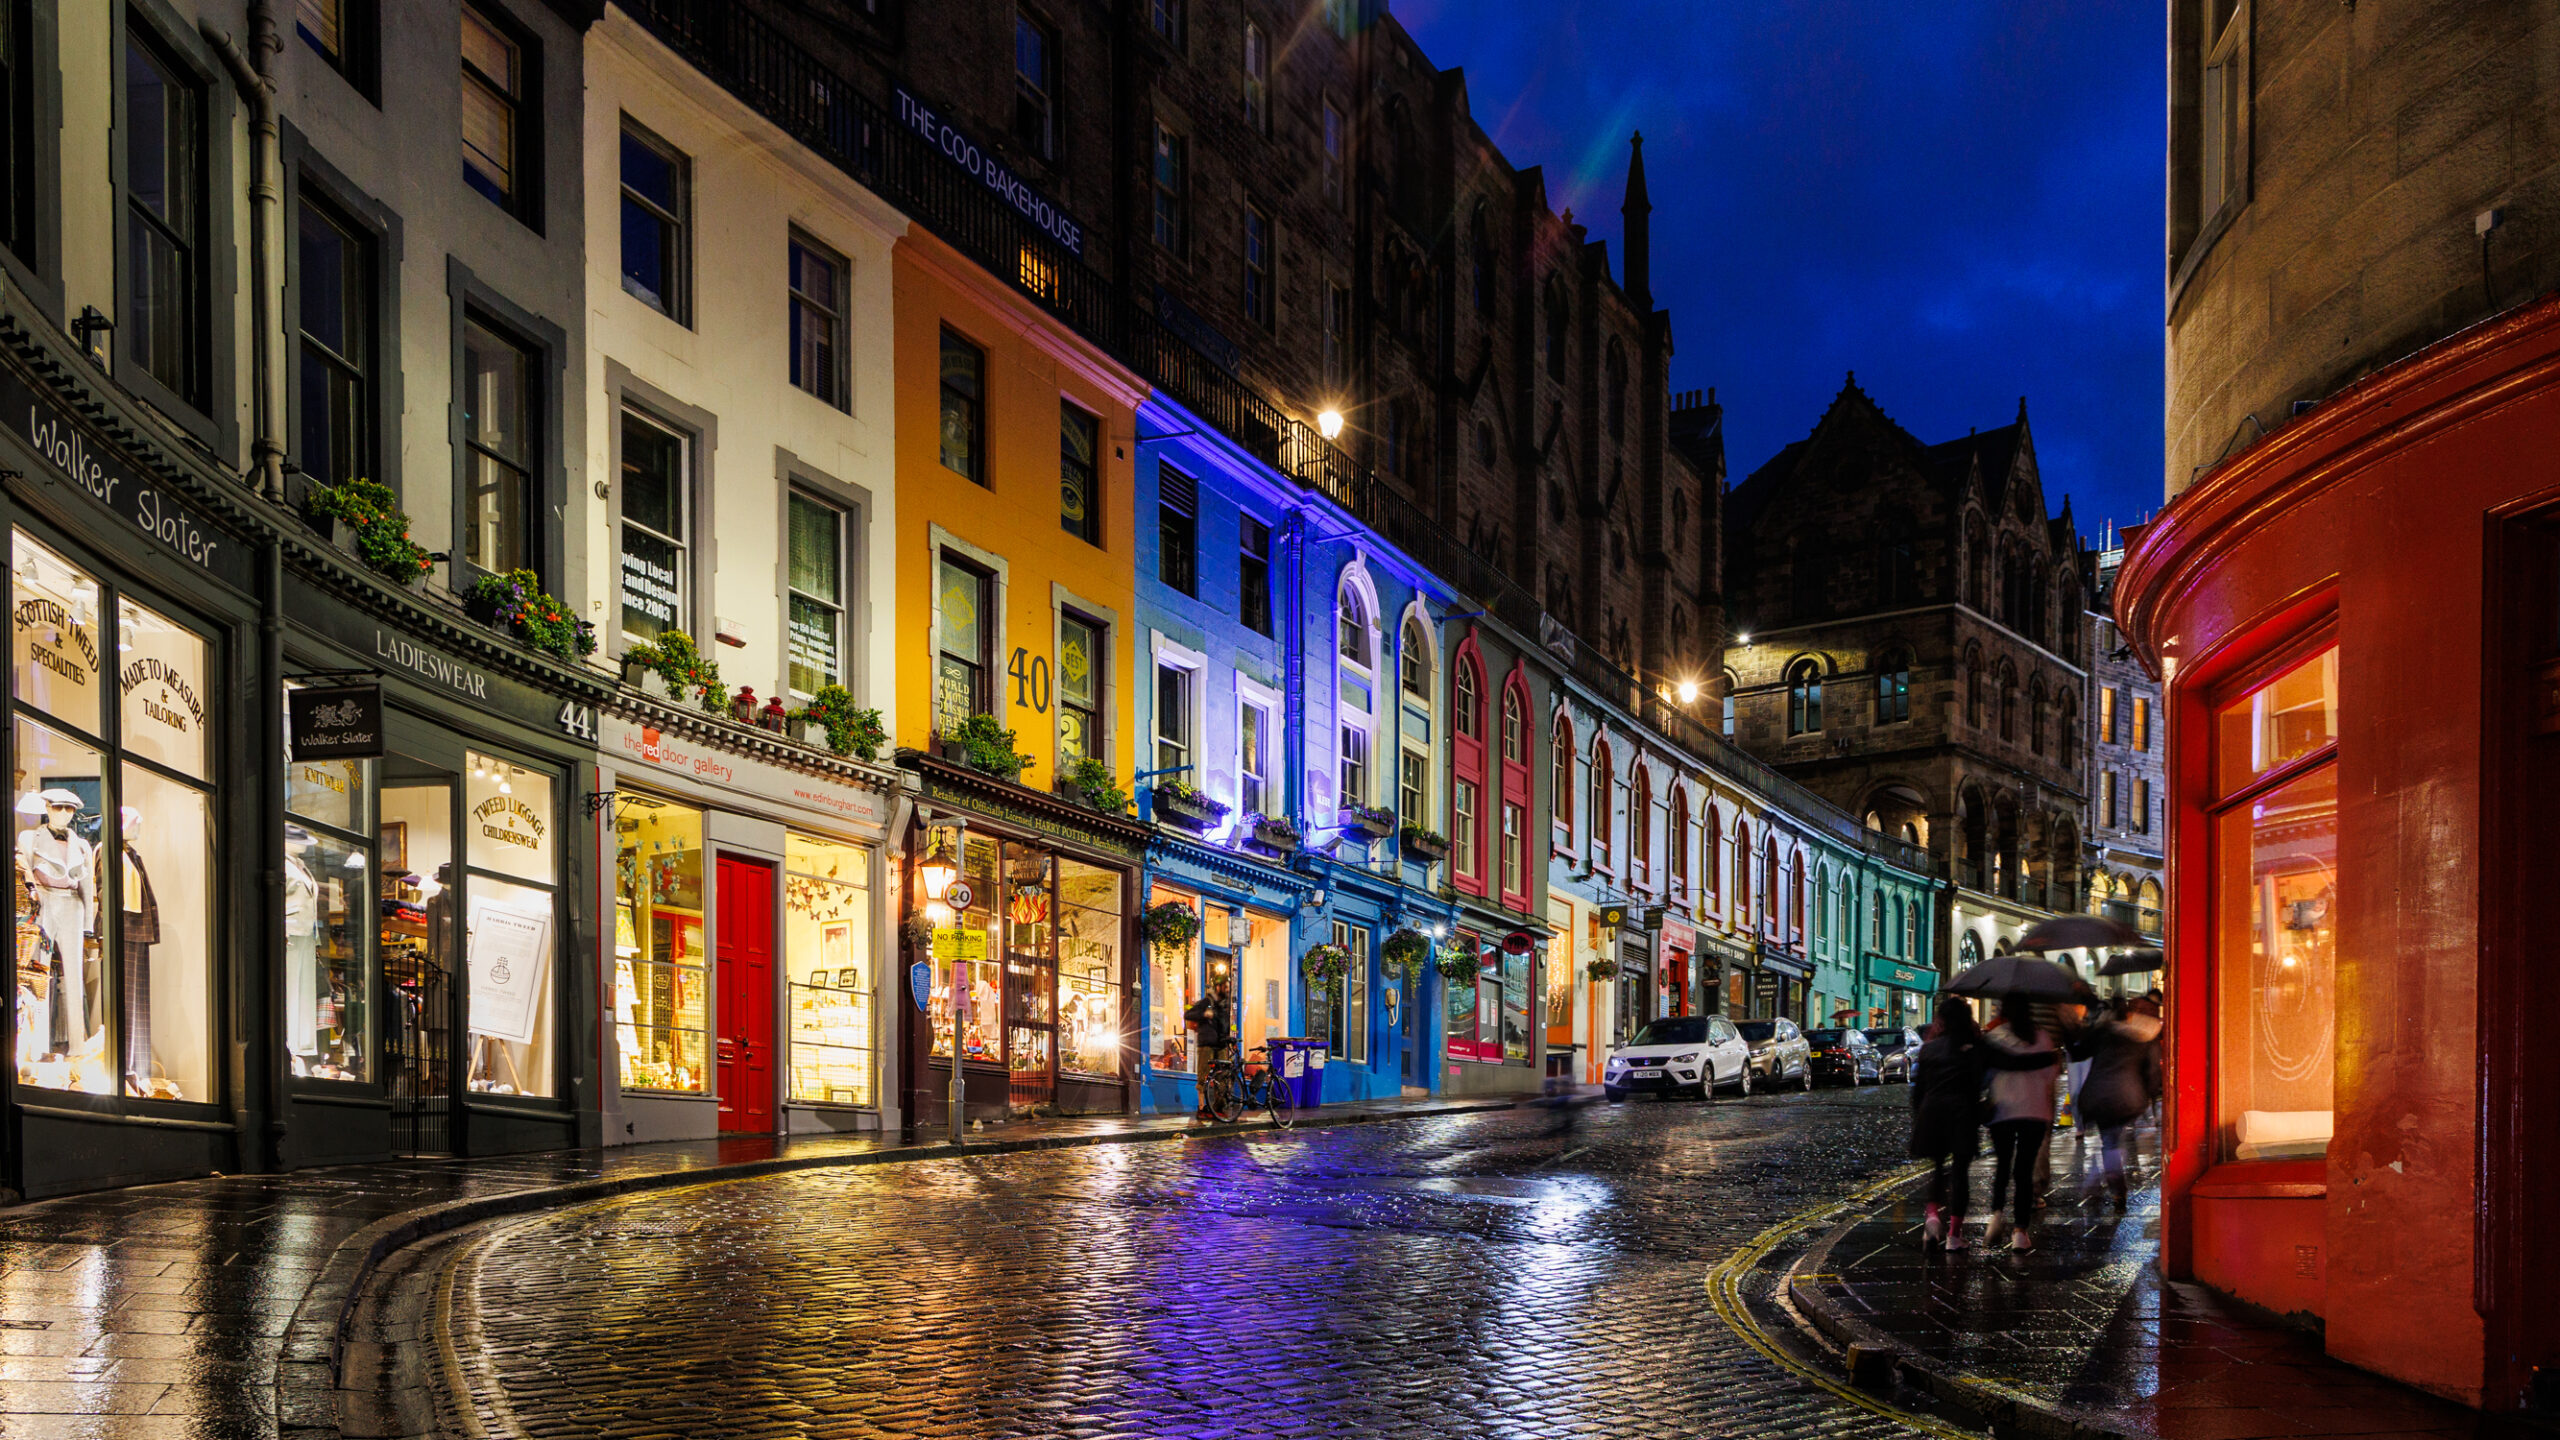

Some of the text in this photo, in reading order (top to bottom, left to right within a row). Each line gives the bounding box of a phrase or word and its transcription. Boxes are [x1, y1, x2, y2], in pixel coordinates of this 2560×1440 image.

[897, 88, 1081, 255] THE COO BAKEHOUSE
[32, 404, 217, 567] Walker Slater
[624, 572, 644, 593] and
[644, 578, 678, 606] Design
[647, 560, 674, 586] Local
[645, 598, 671, 622] 2003
[14, 598, 100, 674] SCOTTISH TWEED
[54, 632, 64, 650] &
[31, 642, 86, 686] SPECIALITIES
[376, 630, 487, 700] LADIESWEAR
[1065, 651, 1085, 670] BEST
[119, 658, 205, 730] MADE TO MEASURE
[161, 688, 169, 704] &
[1007, 646, 1050, 714] 40
[143, 698, 187, 733] TAILORING
[301, 731, 374, 747] Walker Slater
[624, 731, 733, 782] the red door gallery
[473, 796, 546, 840] TWEED LUGGAGE
[793, 788, 874, 817] www.edinburghart.com
[932, 785, 961, 806] Retailer
[961, 796, 970, 807] of
[971, 799, 1004, 820] Officially
[1005, 808, 1034, 829] Licensed
[1035, 818, 1061, 836] HARRY
[1061, 825, 1091, 845] POTTER
[482, 824, 539, 850] CHILDRENSWEAR
[949, 887, 970, 902] 20
[937, 932, 983, 943] NO PARKING
[1068, 937, 1113, 968] MUSEUM
[1707, 940, 1717, 951] THE
[1733, 949, 1746, 961] SHOP
